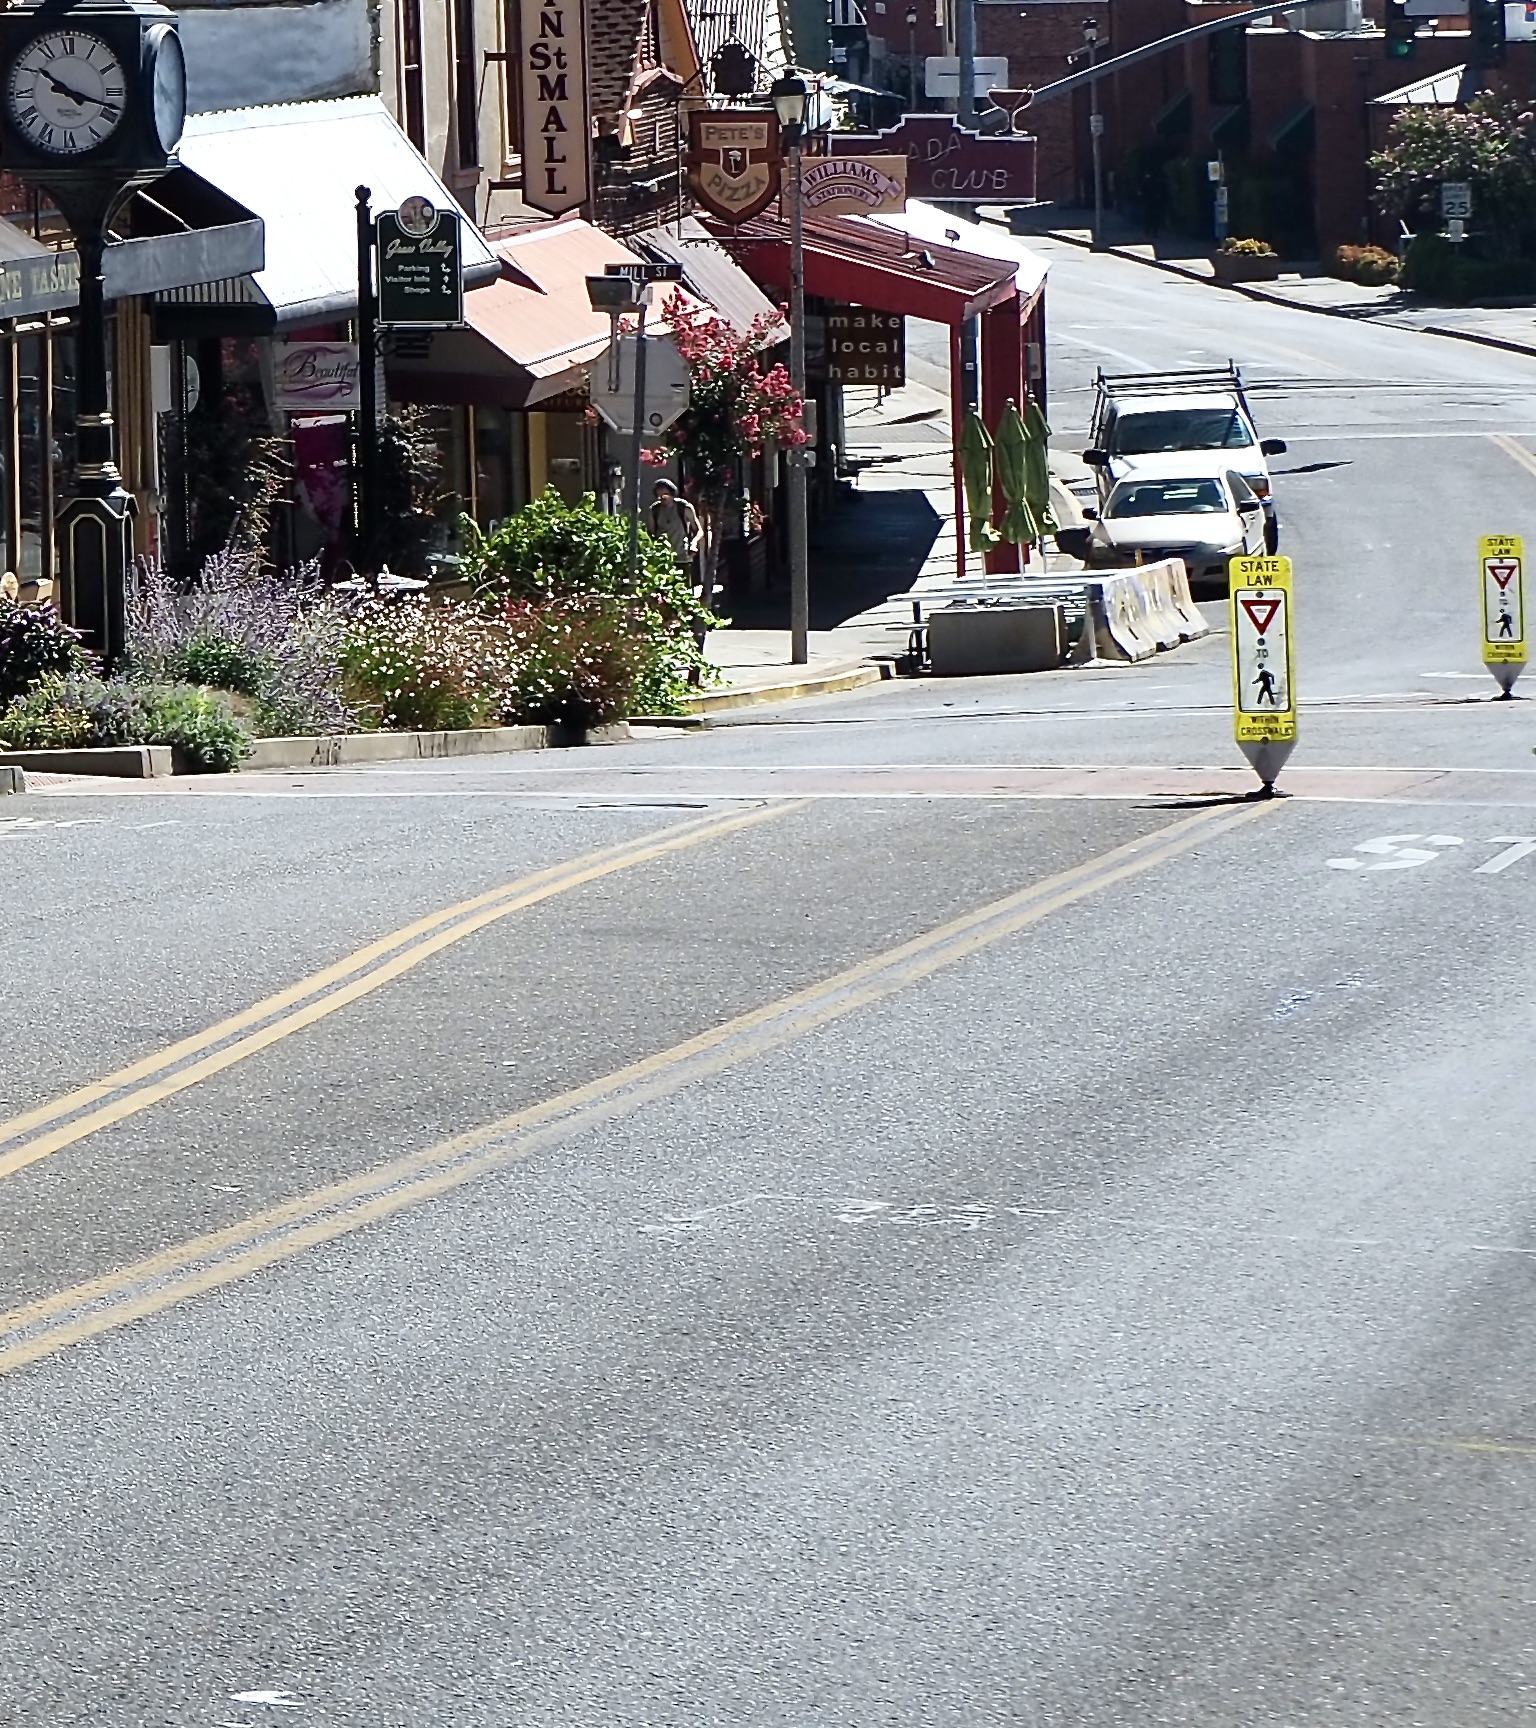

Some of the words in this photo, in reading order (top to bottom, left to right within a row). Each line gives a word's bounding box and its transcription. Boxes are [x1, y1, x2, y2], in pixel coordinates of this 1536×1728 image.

[529, 42, 568, 72] St
[536, 73, 569, 195] MALL
[704, 125, 765, 141] PETE'S
[803, 160, 881, 187] WILLIAMS
[707, 174, 766, 202] PIZZA
[1445, 201, 1469, 216] 25
[619, 266, 648, 280] MILL
[655, 266, 668, 277] ST
[829, 314, 901, 328] make
[832, 338, 898, 353] local
[829, 364, 902, 379] habit
[1487, 538, 1515, 547] STATE
[1492, 548, 1511, 556] LAW
[1240, 561, 1280, 573] STATE
[1246, 575, 1273, 587] LAW
[1255, 648, 1269, 659] TO
